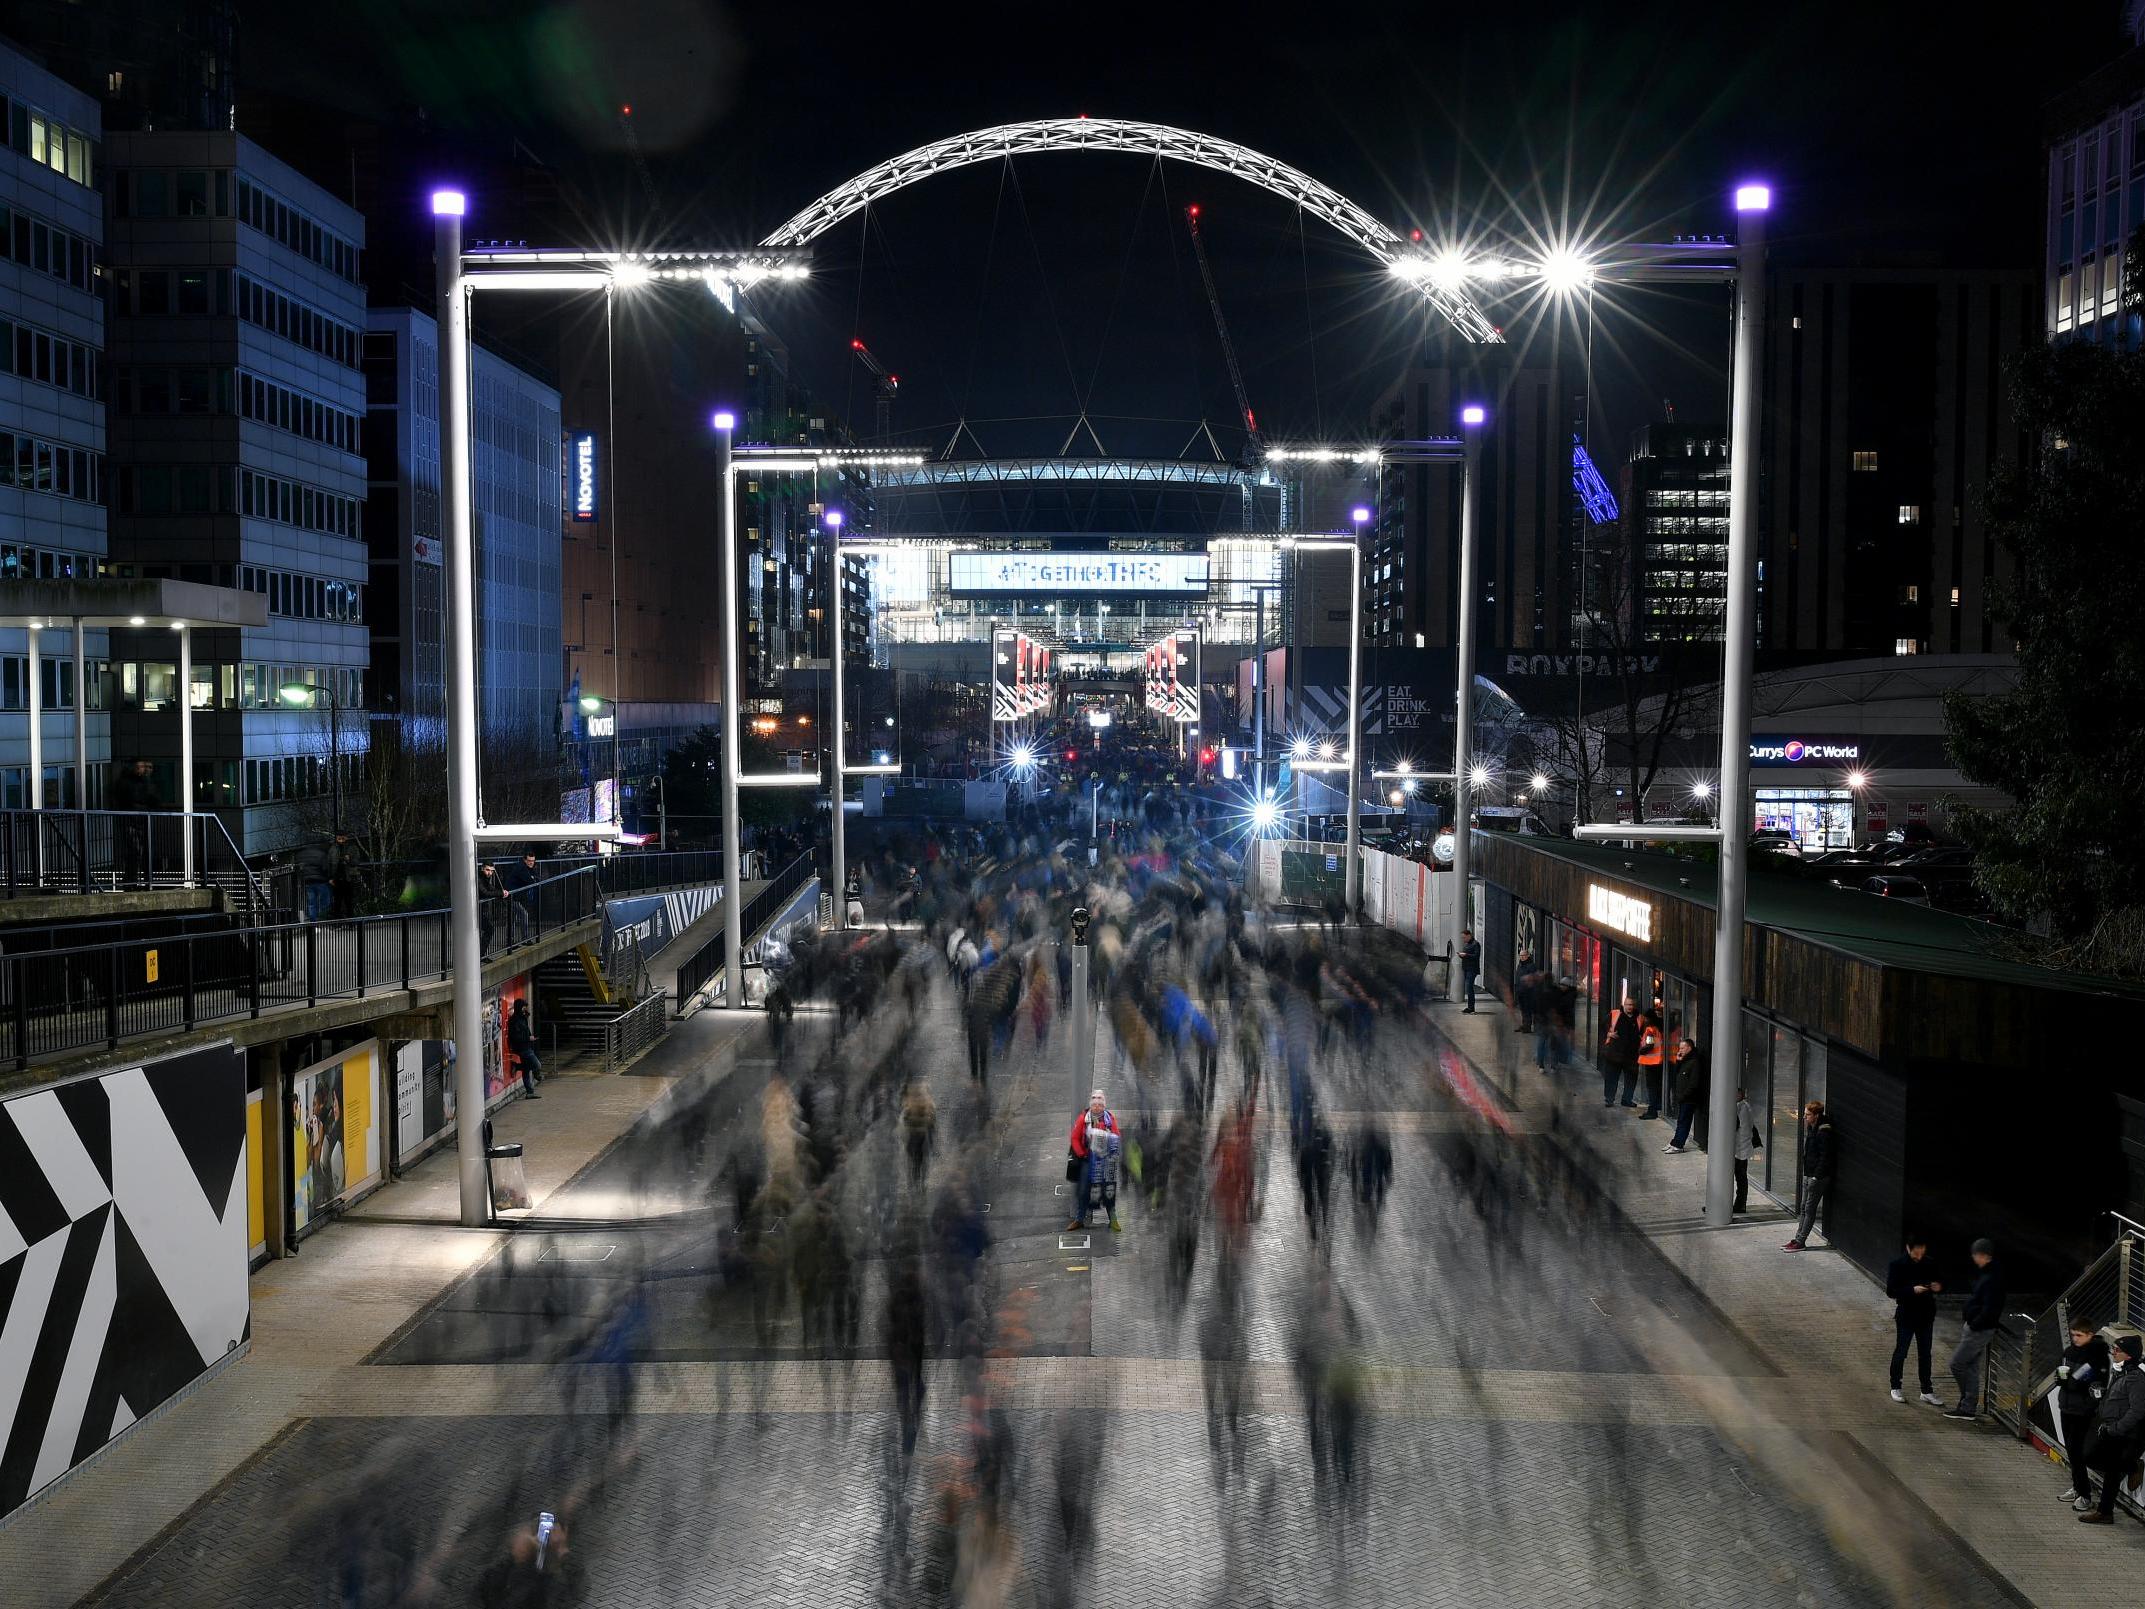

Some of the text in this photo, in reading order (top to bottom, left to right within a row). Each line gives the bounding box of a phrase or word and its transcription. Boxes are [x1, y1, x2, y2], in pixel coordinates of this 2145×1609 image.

[578, 435, 592, 511] NOVOTEL
[1387, 686, 1412, 697] EAT.
[1387, 701, 1431, 712] DRINK.
[1387, 715, 1420, 726] PLAY.
[1804, 746, 1822, 758] PC
[1823, 746, 1857, 758] World
